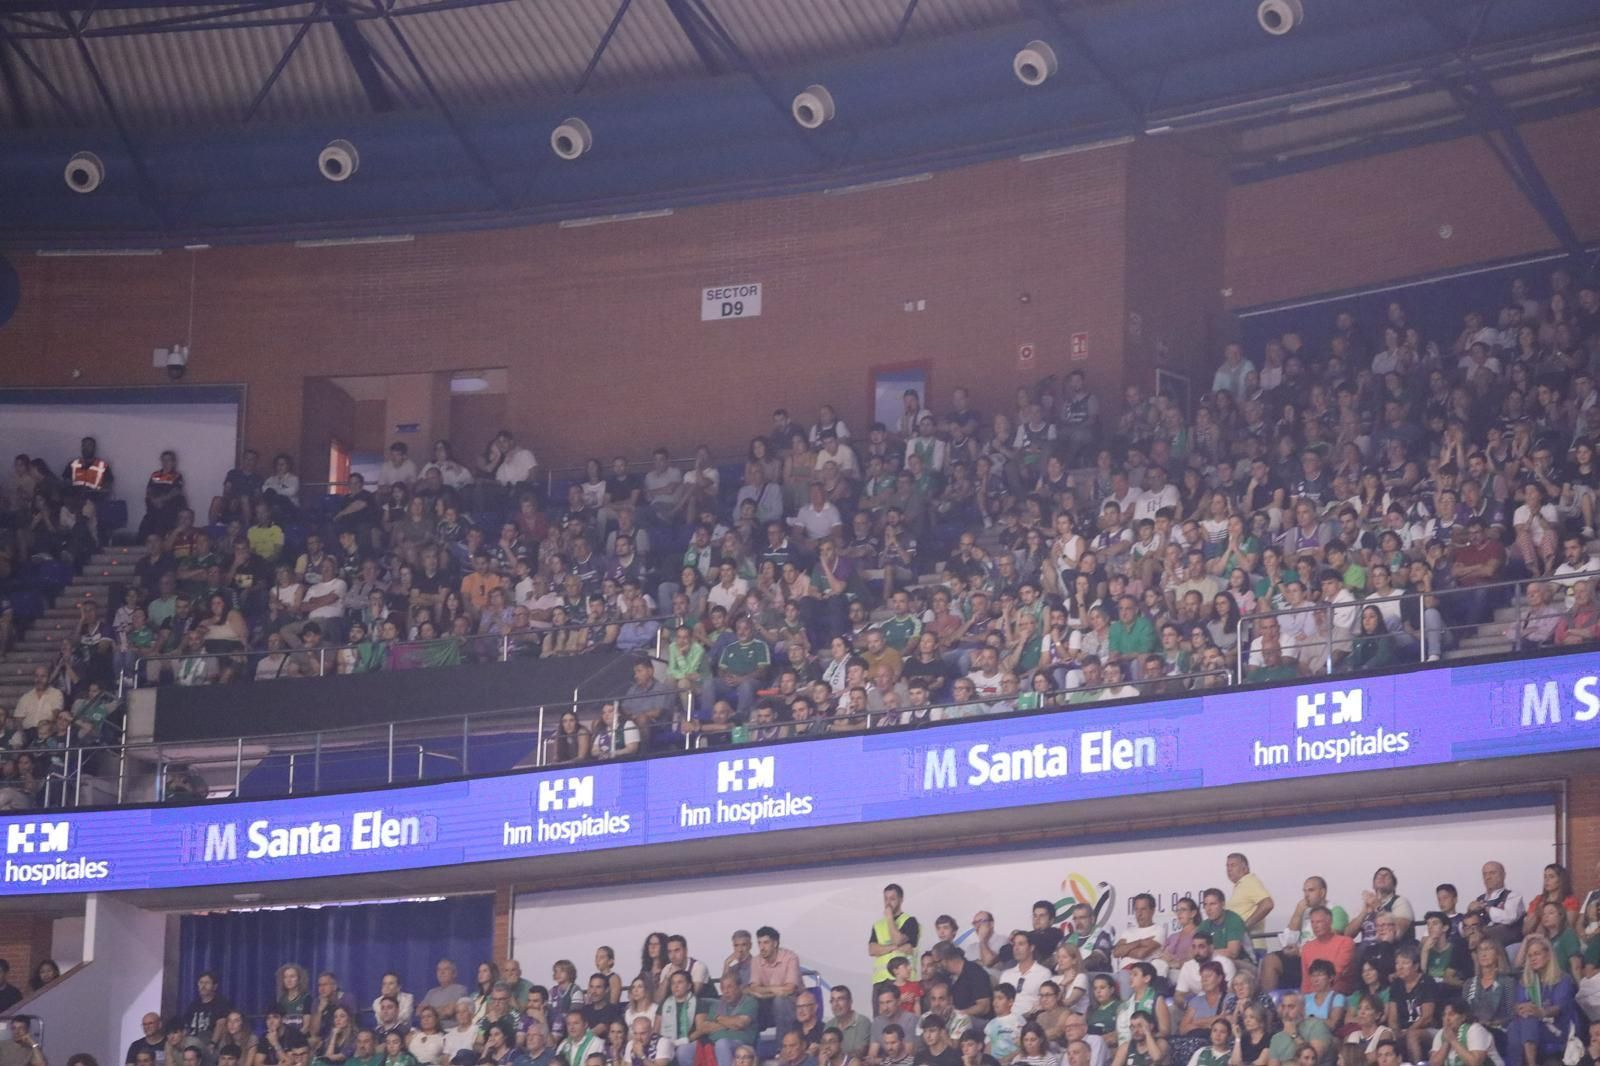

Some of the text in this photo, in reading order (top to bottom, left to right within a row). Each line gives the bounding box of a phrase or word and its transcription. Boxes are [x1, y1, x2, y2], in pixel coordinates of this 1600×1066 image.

[706, 285, 758, 301] SECTOR
[721, 301, 744, 317] D9
[1254, 726, 1410, 766] hm hospitales
[967, 743, 1068, 786] Santa
[680, 791, 813, 827] hm hospitales
[247, 820, 341, 859] Santa
[503, 811, 630, 846] hm hospitales
[5, 856, 109, 886] hospitales
